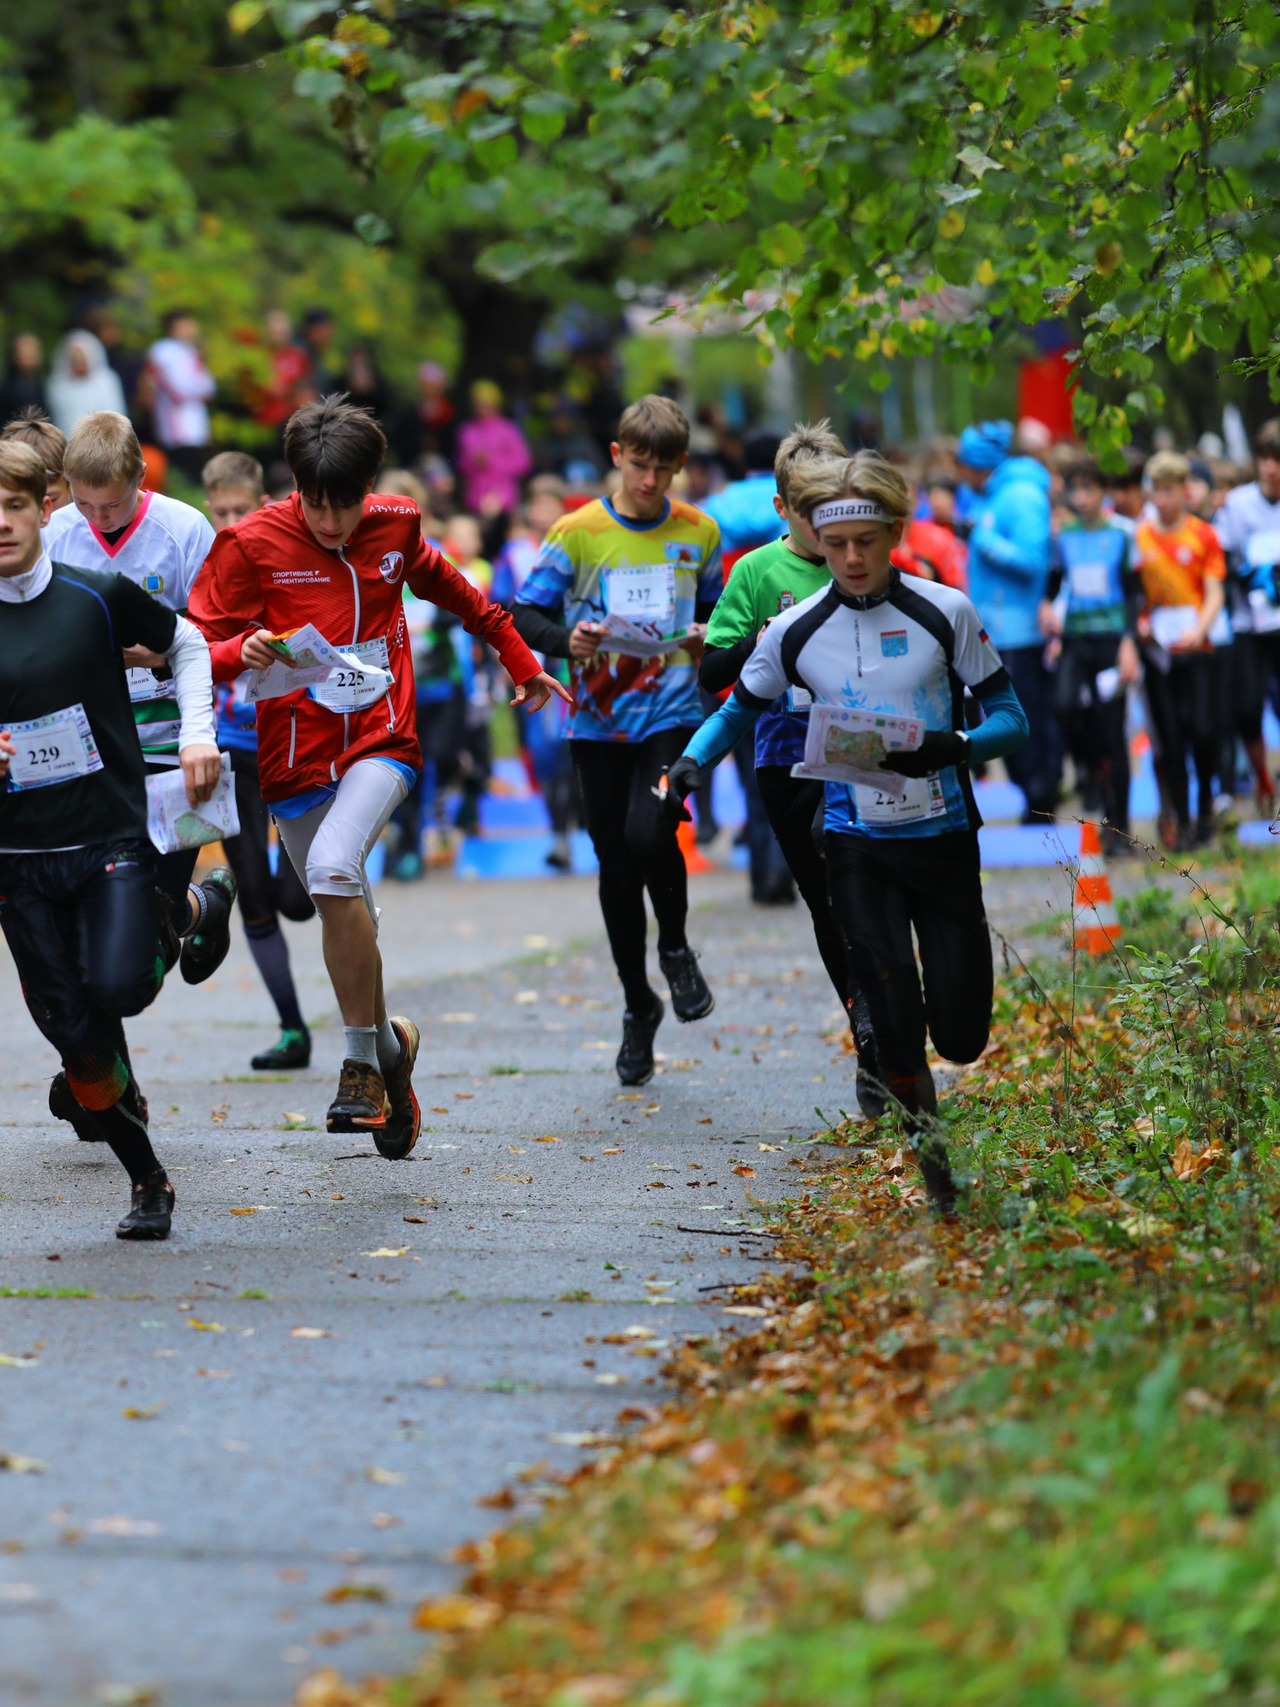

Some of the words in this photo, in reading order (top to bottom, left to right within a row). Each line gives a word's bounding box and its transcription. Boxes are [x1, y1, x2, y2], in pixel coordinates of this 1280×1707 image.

[818, 503, 881, 520] noname
[627, 588, 651, 602] 237
[337, 671, 365, 687] 225
[28, 746, 60, 765] 229
